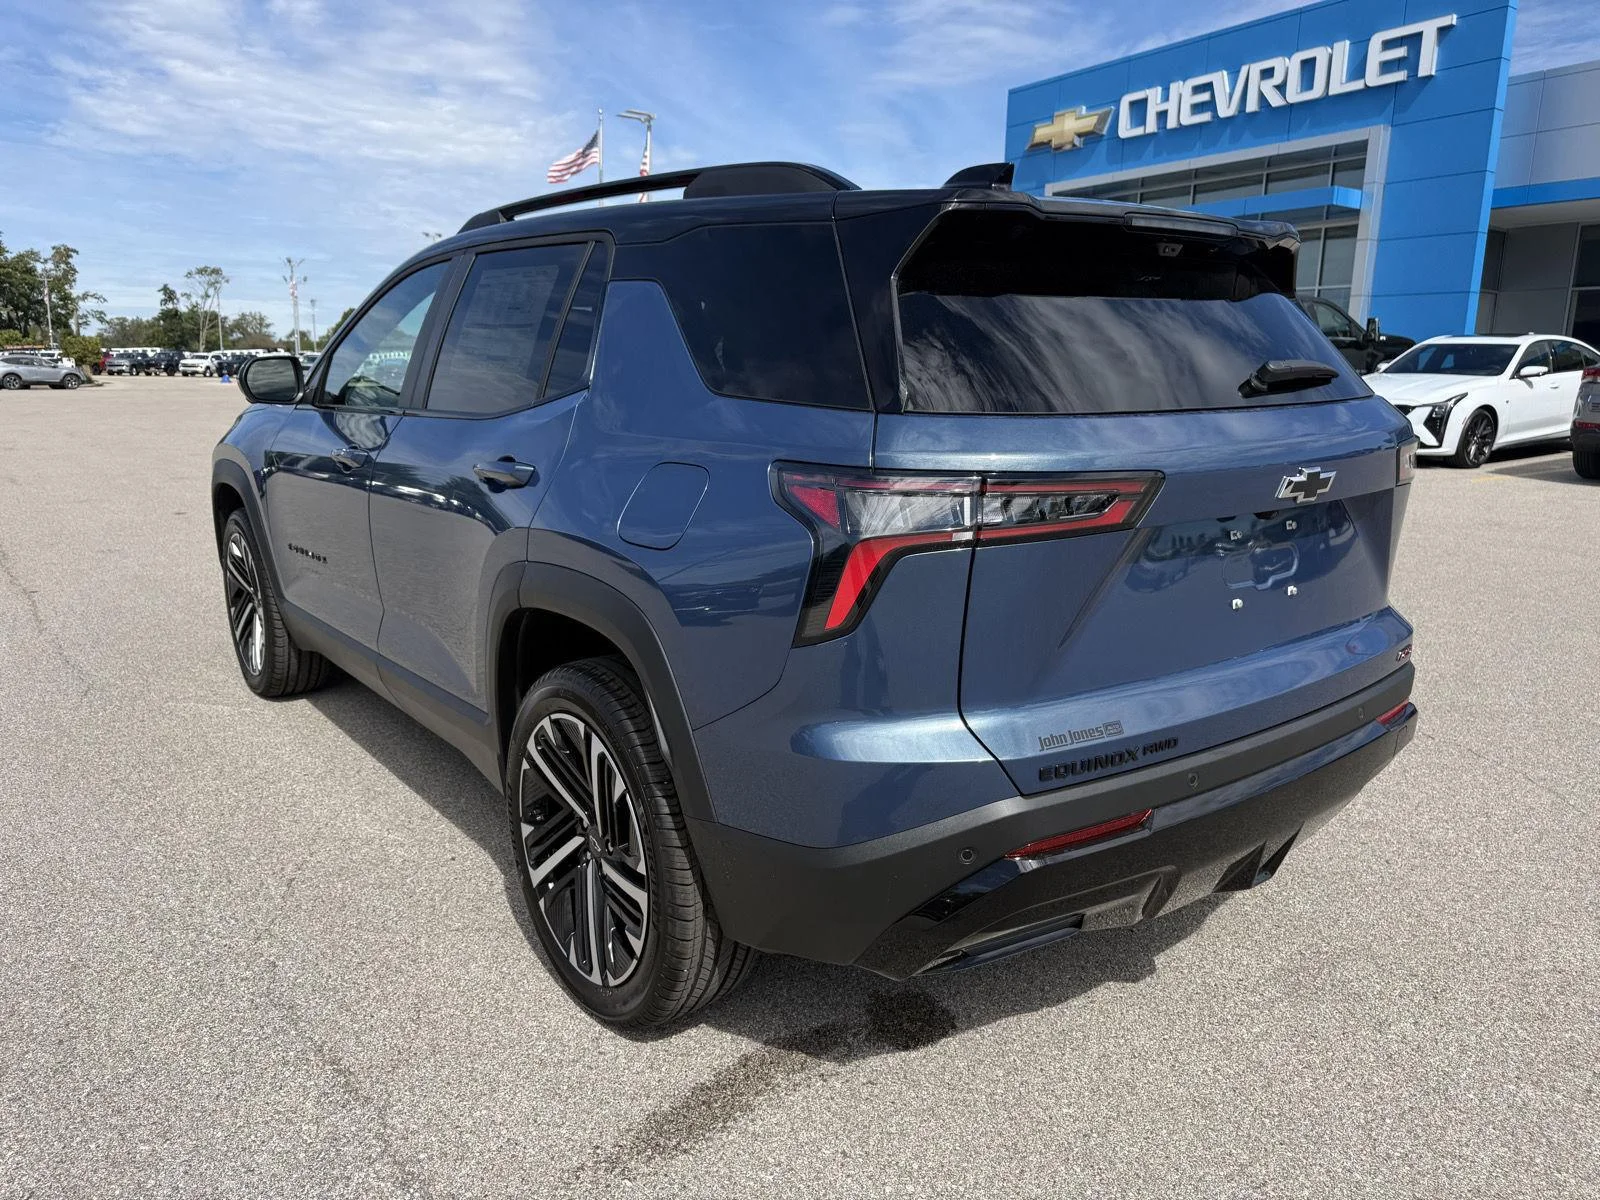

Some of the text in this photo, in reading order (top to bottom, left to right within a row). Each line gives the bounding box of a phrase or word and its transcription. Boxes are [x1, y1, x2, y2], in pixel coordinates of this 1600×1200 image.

[1118, 14, 1458, 138] CHEVROLET
[1068, 725, 1104, 745] Jones
[1039, 737, 1178, 782] EQUINOX AWD
